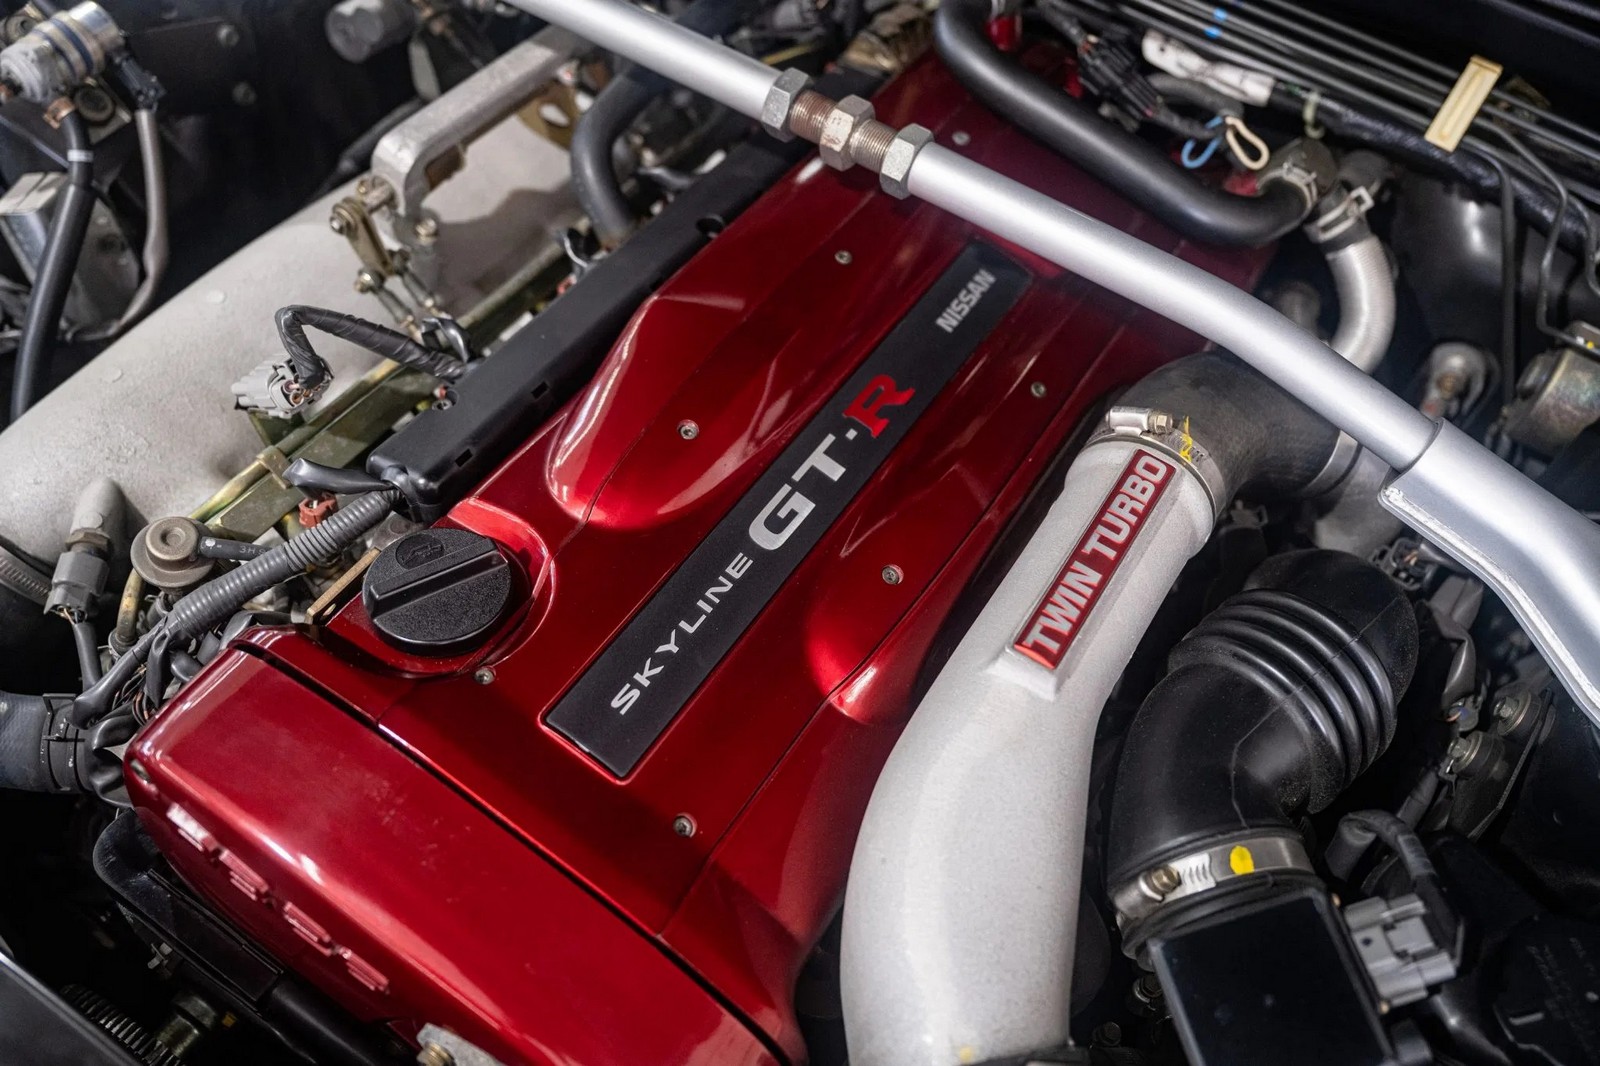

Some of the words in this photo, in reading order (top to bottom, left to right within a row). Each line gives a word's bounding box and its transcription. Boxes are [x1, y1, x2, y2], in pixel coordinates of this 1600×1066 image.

[935, 269, 996, 333] NISSAN
[610, 552, 754, 716] SKYLINE
[1021, 561, 1103, 654] TWIN
[1081, 455, 1168, 561] TURBO
